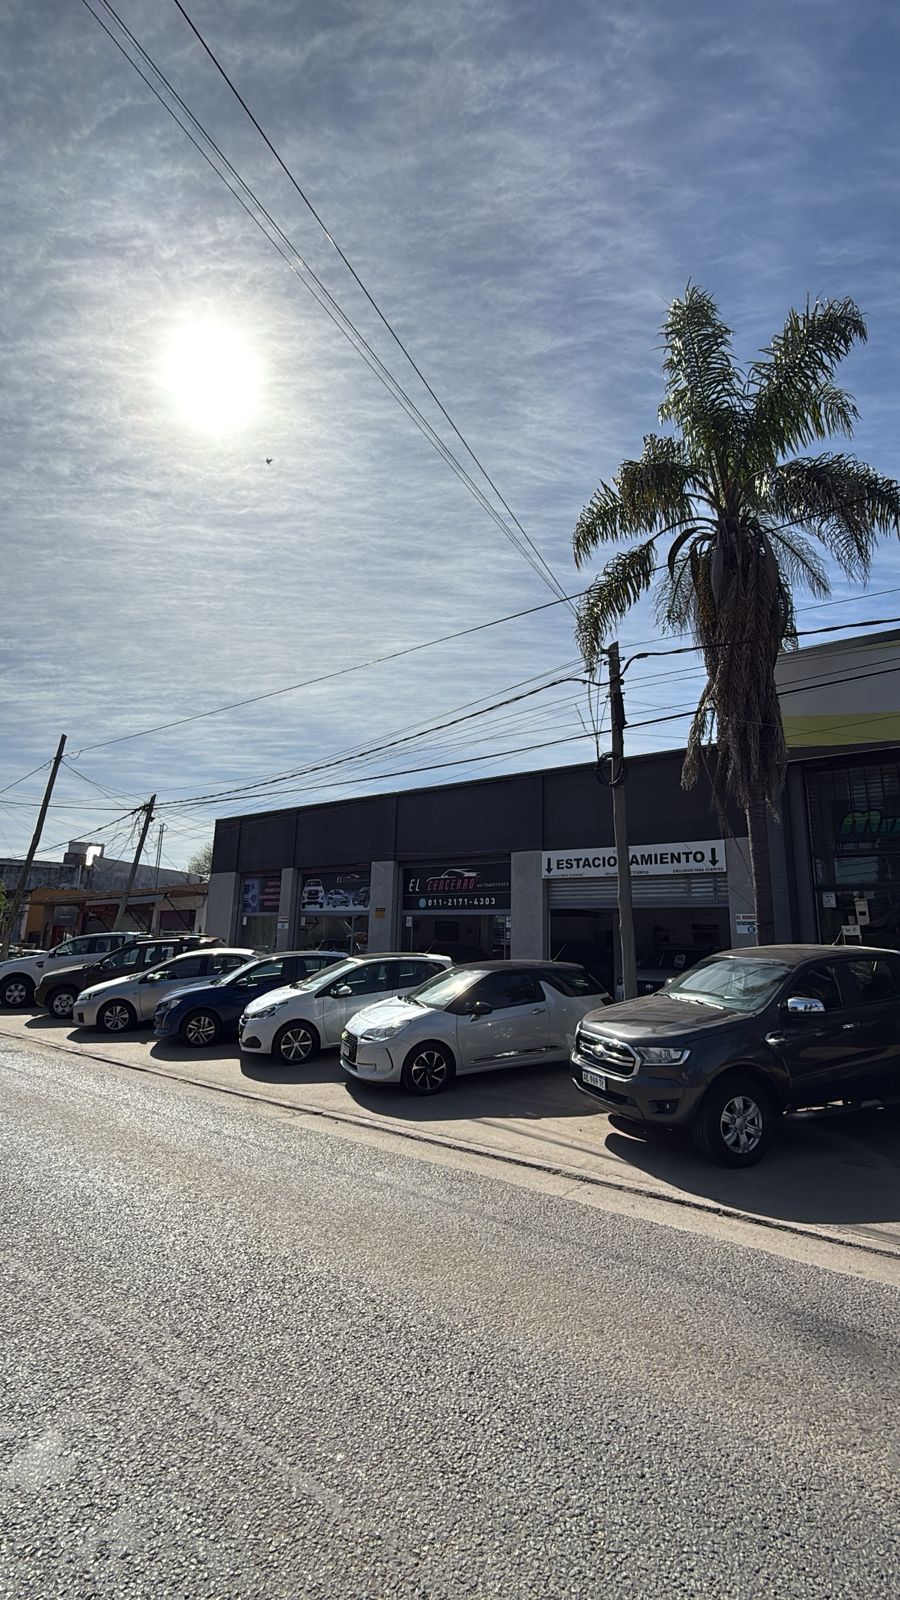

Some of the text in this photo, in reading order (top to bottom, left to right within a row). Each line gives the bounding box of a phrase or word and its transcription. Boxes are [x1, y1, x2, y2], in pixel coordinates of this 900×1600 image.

[556, 851, 705, 870] ESTACIOAMIENTO
[408, 878, 420, 892] EL
[427, 878, 475, 891] CENCERRO
[427, 897, 496, 906] 011-2171-4303
